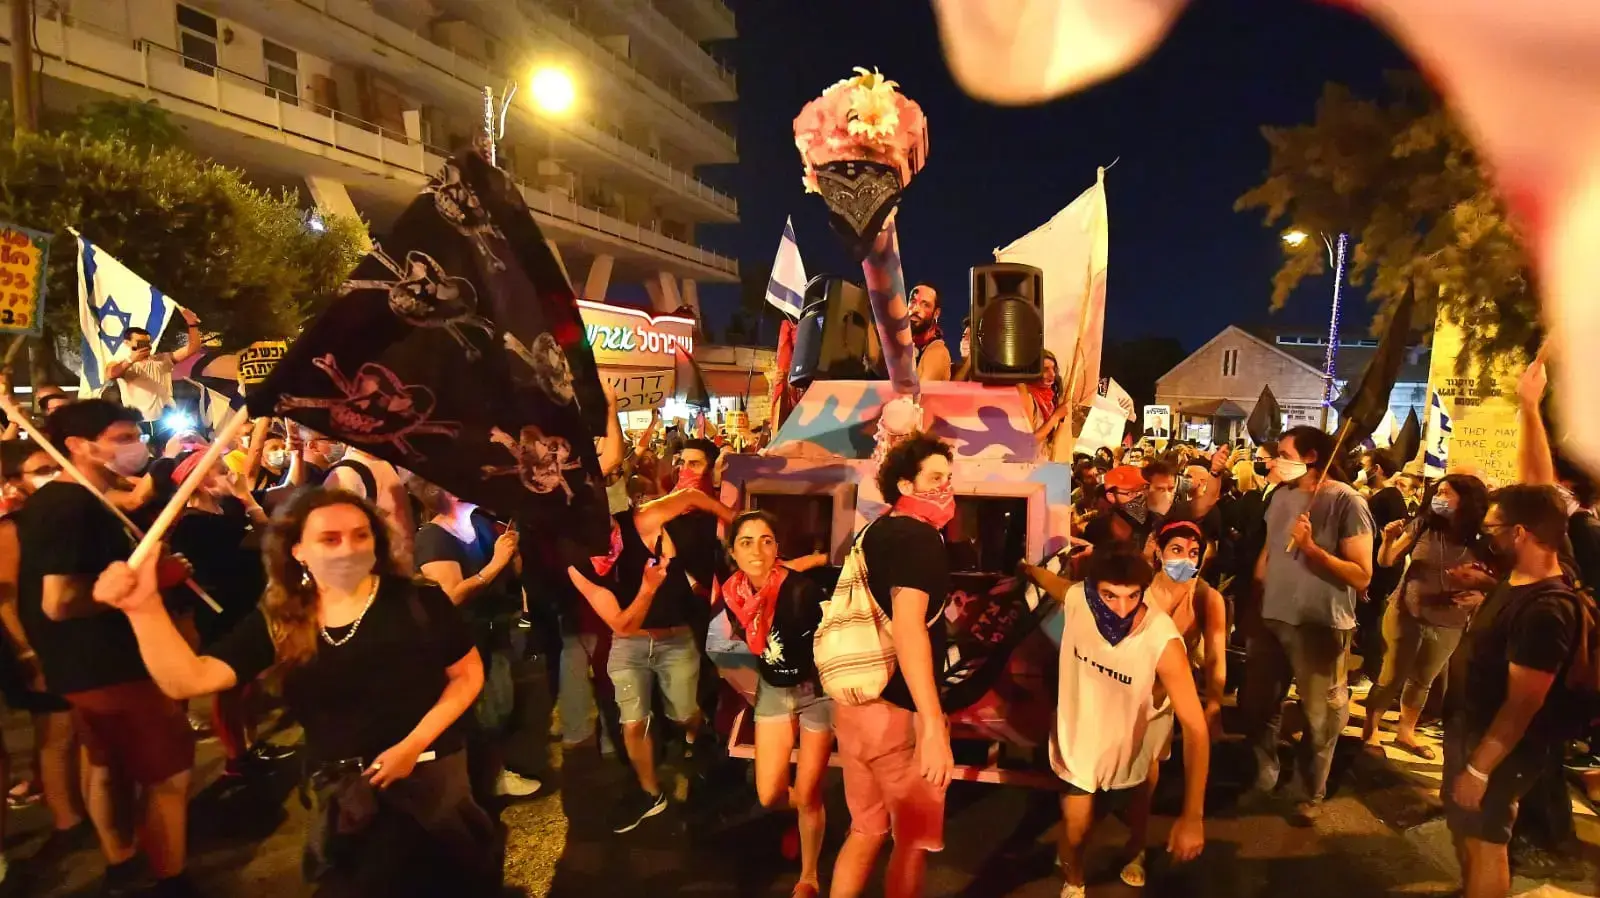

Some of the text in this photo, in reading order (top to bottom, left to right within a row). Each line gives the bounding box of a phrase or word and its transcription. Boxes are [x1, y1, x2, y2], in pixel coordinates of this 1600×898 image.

[1463, 427, 1518, 437] THEY MAY
[1456, 439, 1517, 450] TAKE OUR
